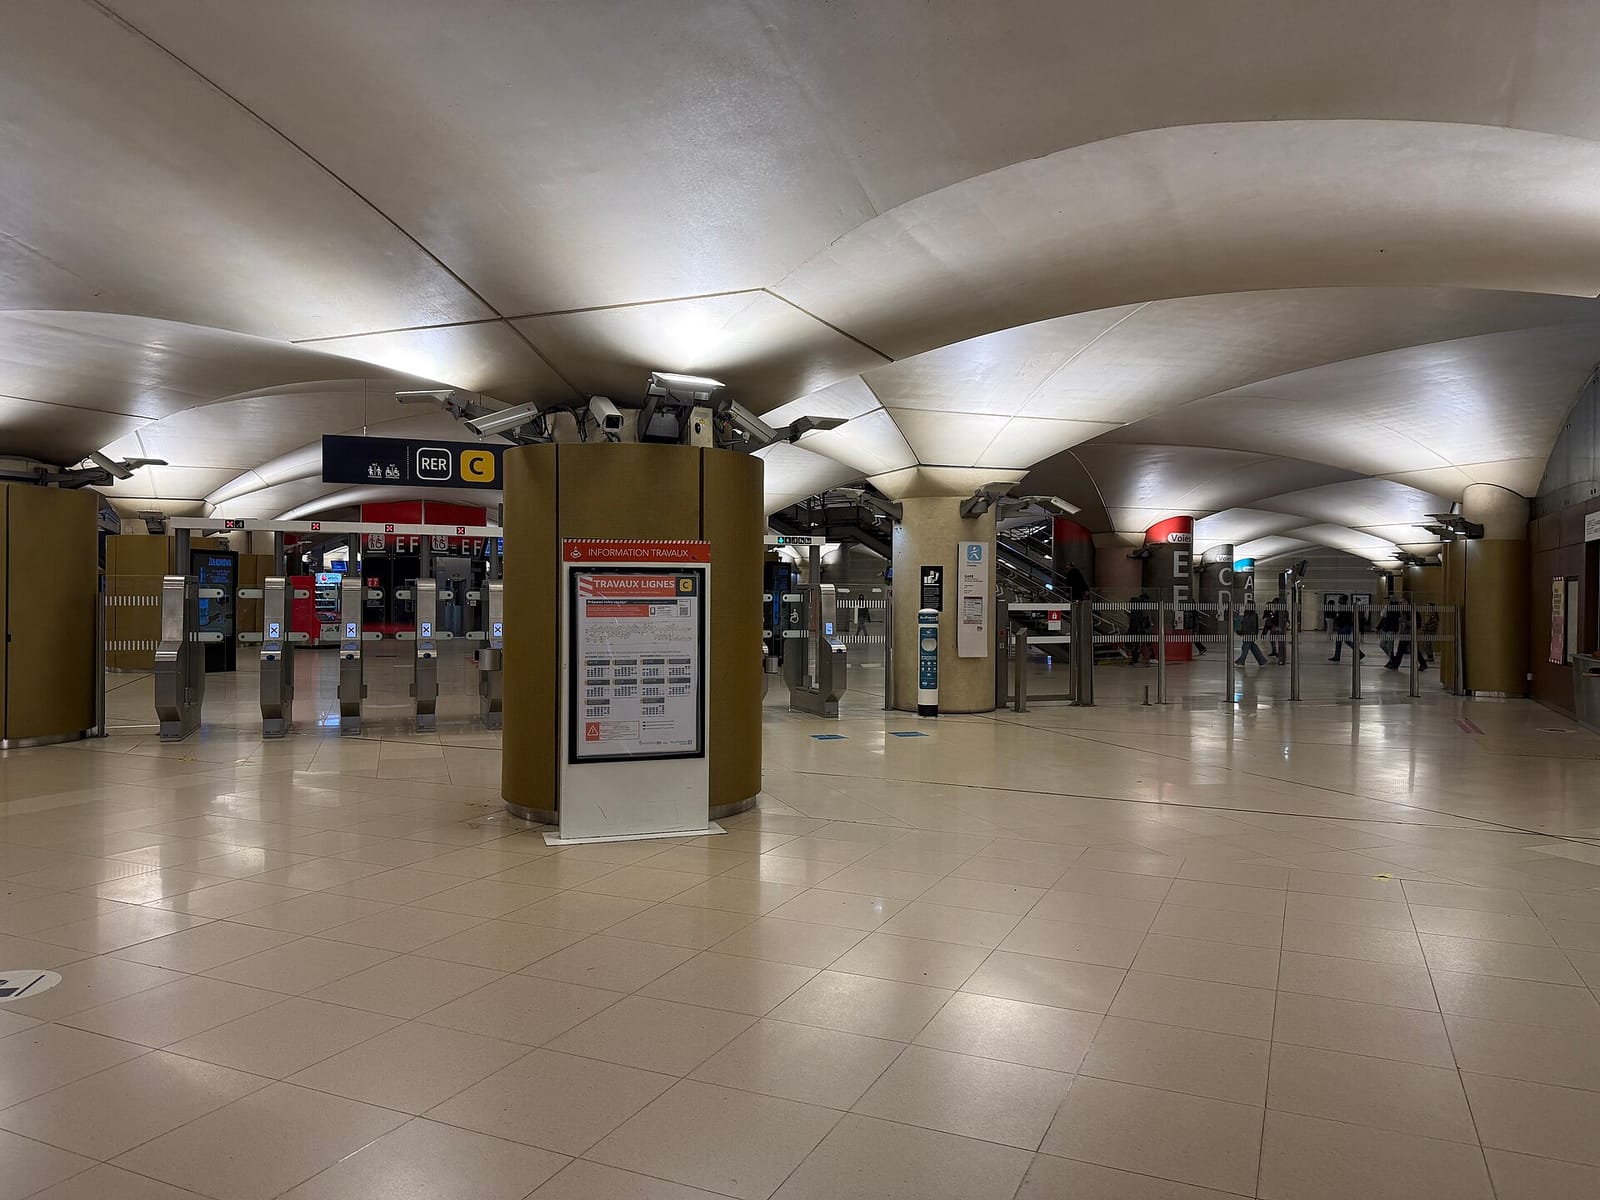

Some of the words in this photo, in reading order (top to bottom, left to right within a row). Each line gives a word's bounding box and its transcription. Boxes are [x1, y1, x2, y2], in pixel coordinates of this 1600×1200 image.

[421, 457, 447, 471] RER
[469, 457, 484, 475] C
[588, 548, 649, 557] INFORMATION
[651, 549, 689, 557] TRAVAUX
[1173, 550, 1189, 578] E
[594, 580, 639, 588] TRAVAUX
[641, 580, 675, 588] LIGNES
[1218, 567, 1232, 586] C
[1244, 575, 1254, 589] A
